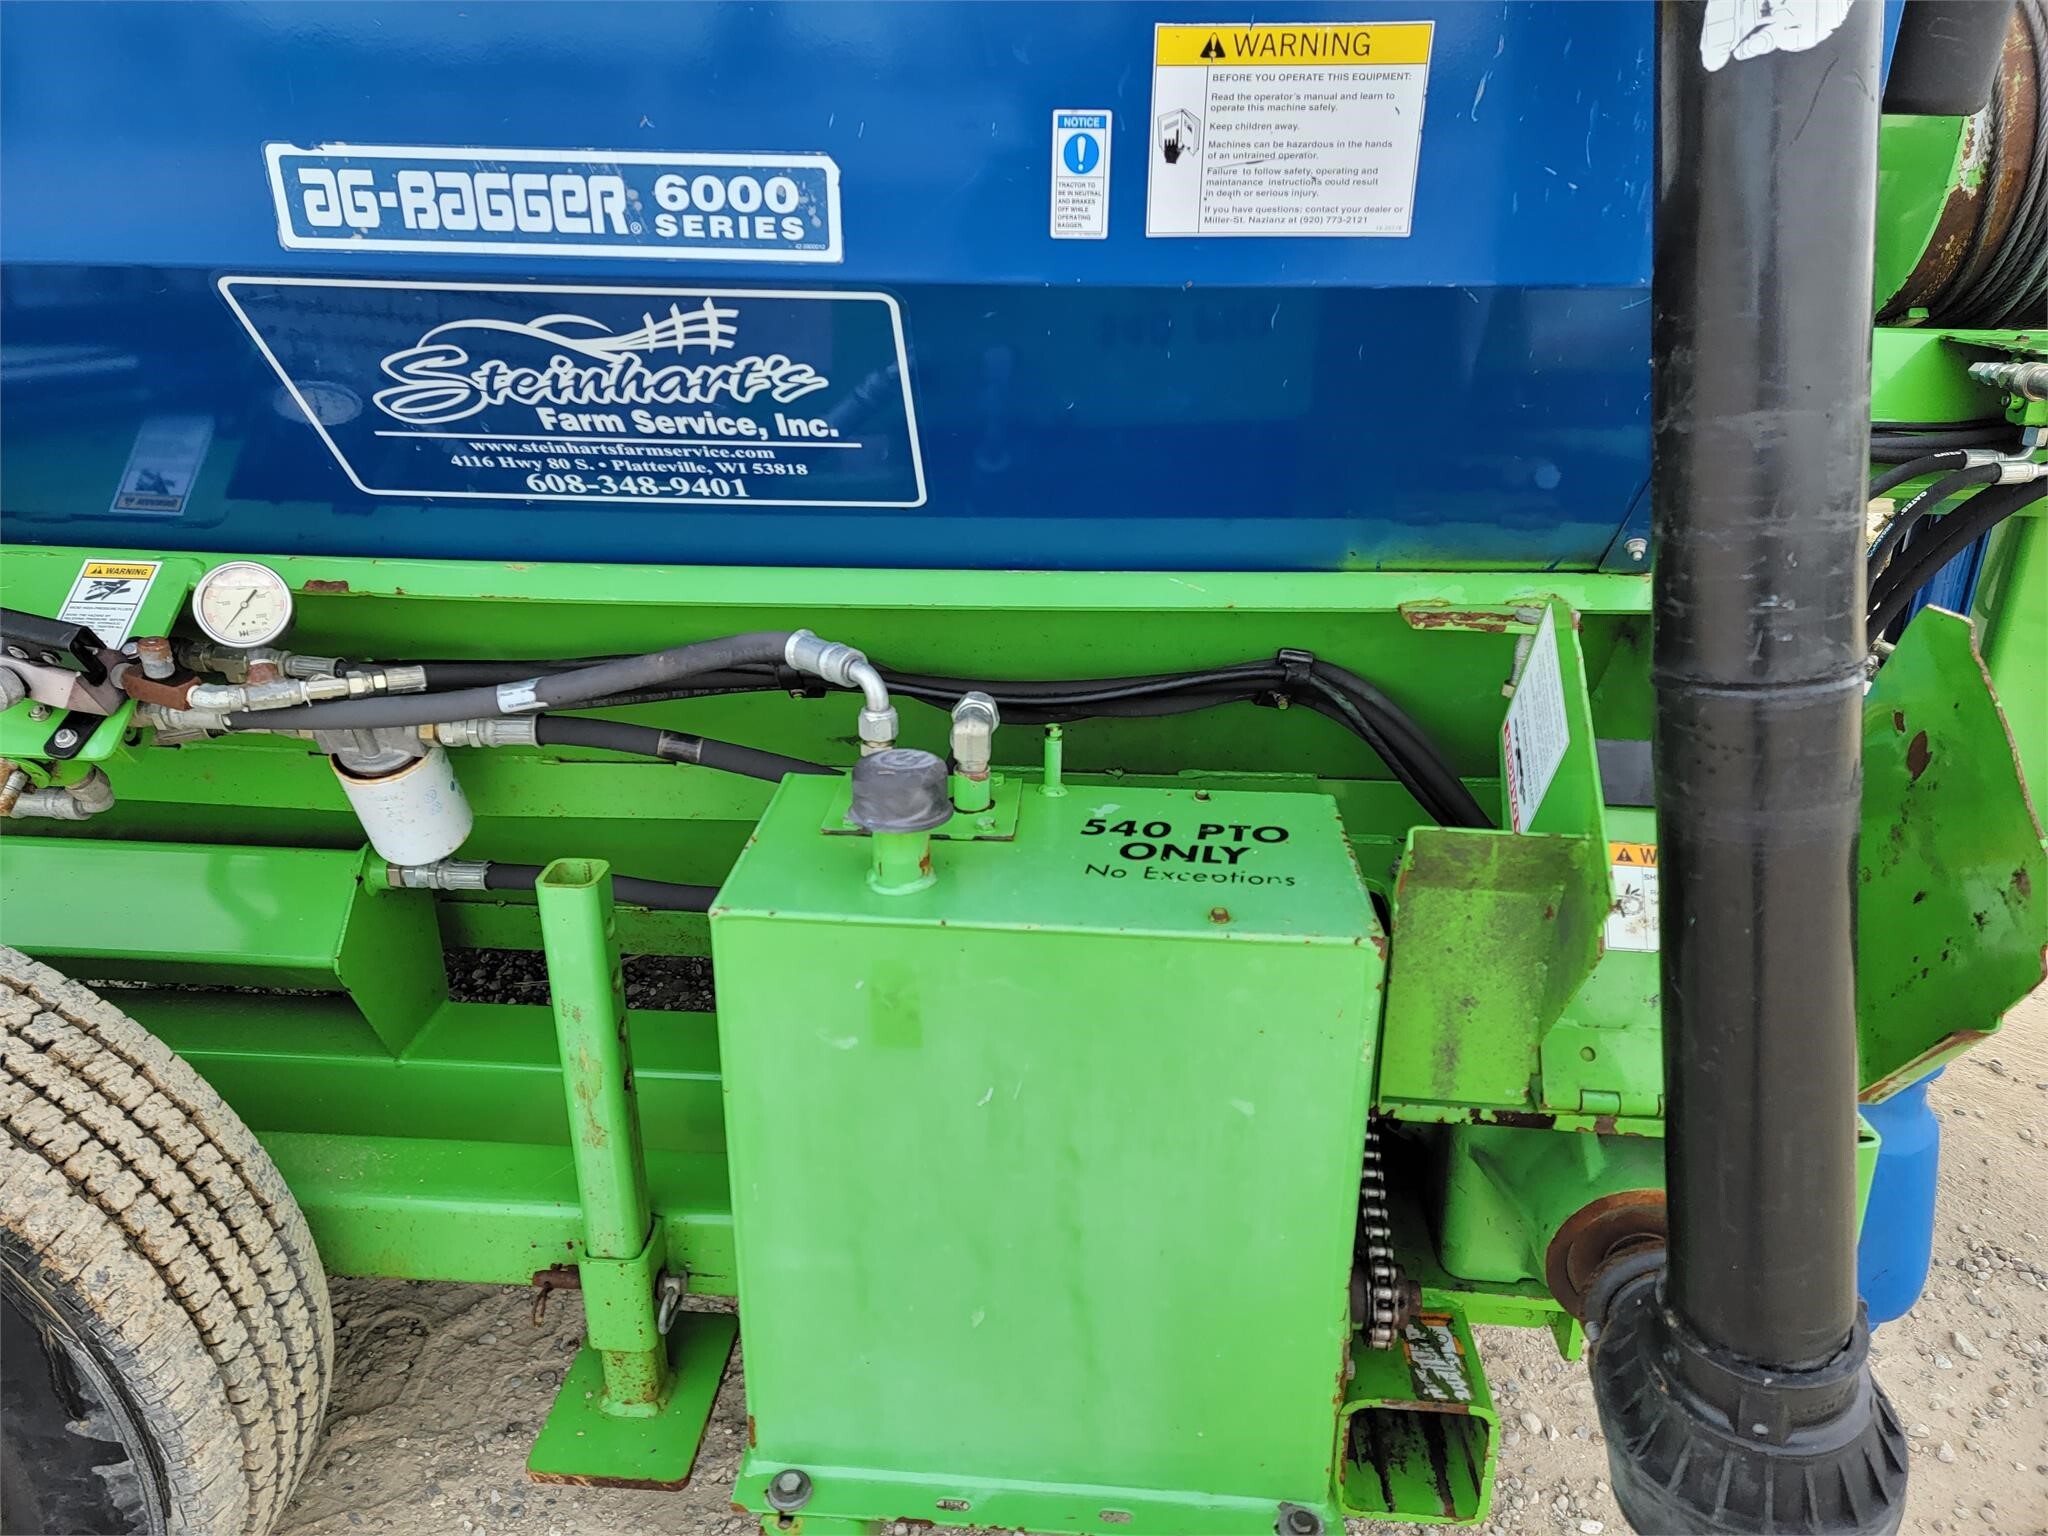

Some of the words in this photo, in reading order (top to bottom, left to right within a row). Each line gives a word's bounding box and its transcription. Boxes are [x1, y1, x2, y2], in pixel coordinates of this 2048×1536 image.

[1233, 32, 1371, 57] WARNING
[1212, 74, 1252, 82] BEFORE
[1328, 73, 1350, 81] THIS
[1352, 72, 1412, 80] EQUIPMENT:
[1211, 93, 1234, 101] Read
[1237, 93, 1252, 101] the
[1254, 93, 1301, 102] operator's
[1304, 92, 1338, 100] manual
[1340, 92, 1356, 100] and
[1360, 92, 1383, 100] learn
[1210, 104, 1244, 113] operate
[1308, 103, 1338, 112] safely.
[1063, 117, 1100, 127] NOTICE
[1209, 123, 1232, 132] Keep
[1235, 122, 1272, 130] children
[1275, 124, 1300, 132] away.
[1286, 140, 1334, 148] hazardous
[1336, 140, 1345, 148] in
[1348, 140, 1362, 148] the
[1364, 140, 1392, 148] hands
[1278, 152, 1318, 160] operator.
[1316, 168, 1358, 176] operating
[1361, 167, 1378, 175] and
[1268, 178, 1322, 186] instructions
[1324, 178, 1350, 186] could
[1352, 178, 1378, 186] result
[653, 173, 800, 214] 6000
[1216, 189, 1241, 197] death
[1256, 189, 1288, 197] serious
[1291, 189, 1318, 199] injury.
[1364, 205, 1391, 213] dealer
[1248, 216, 1286, 224] Nazianz
[1300, 216, 1324, 224] (920)
[1326, 216, 1368, 224] 773-2121
[654, 214, 806, 241] SERIES
[372, 344, 829, 425] Steinhart's
[538, 407, 631, 434] Farm
[637, 410, 768, 441] Service,
[775, 413, 839, 438] Inc.
[468, 441, 776, 460] www.steinhartsfarmservice.com
[450, 454, 495, 469] 4116
[498, 457, 542, 473] Hwy
[547, 458, 574, 470] 80
[576, 459, 595, 471] S.
[611, 459, 714, 476] Platteville,
[716, 462, 748, 474] WI
[752, 463, 808, 476] 53818
[525, 473, 751, 499] 608-348-9401
[105, 567, 148, 576] WARNING
[1080, 819, 1172, 839] 540
[1197, 823, 1289, 843] PTO
[1120, 842, 1252, 864] ONLY
[1084, 864, 1127, 879] No
